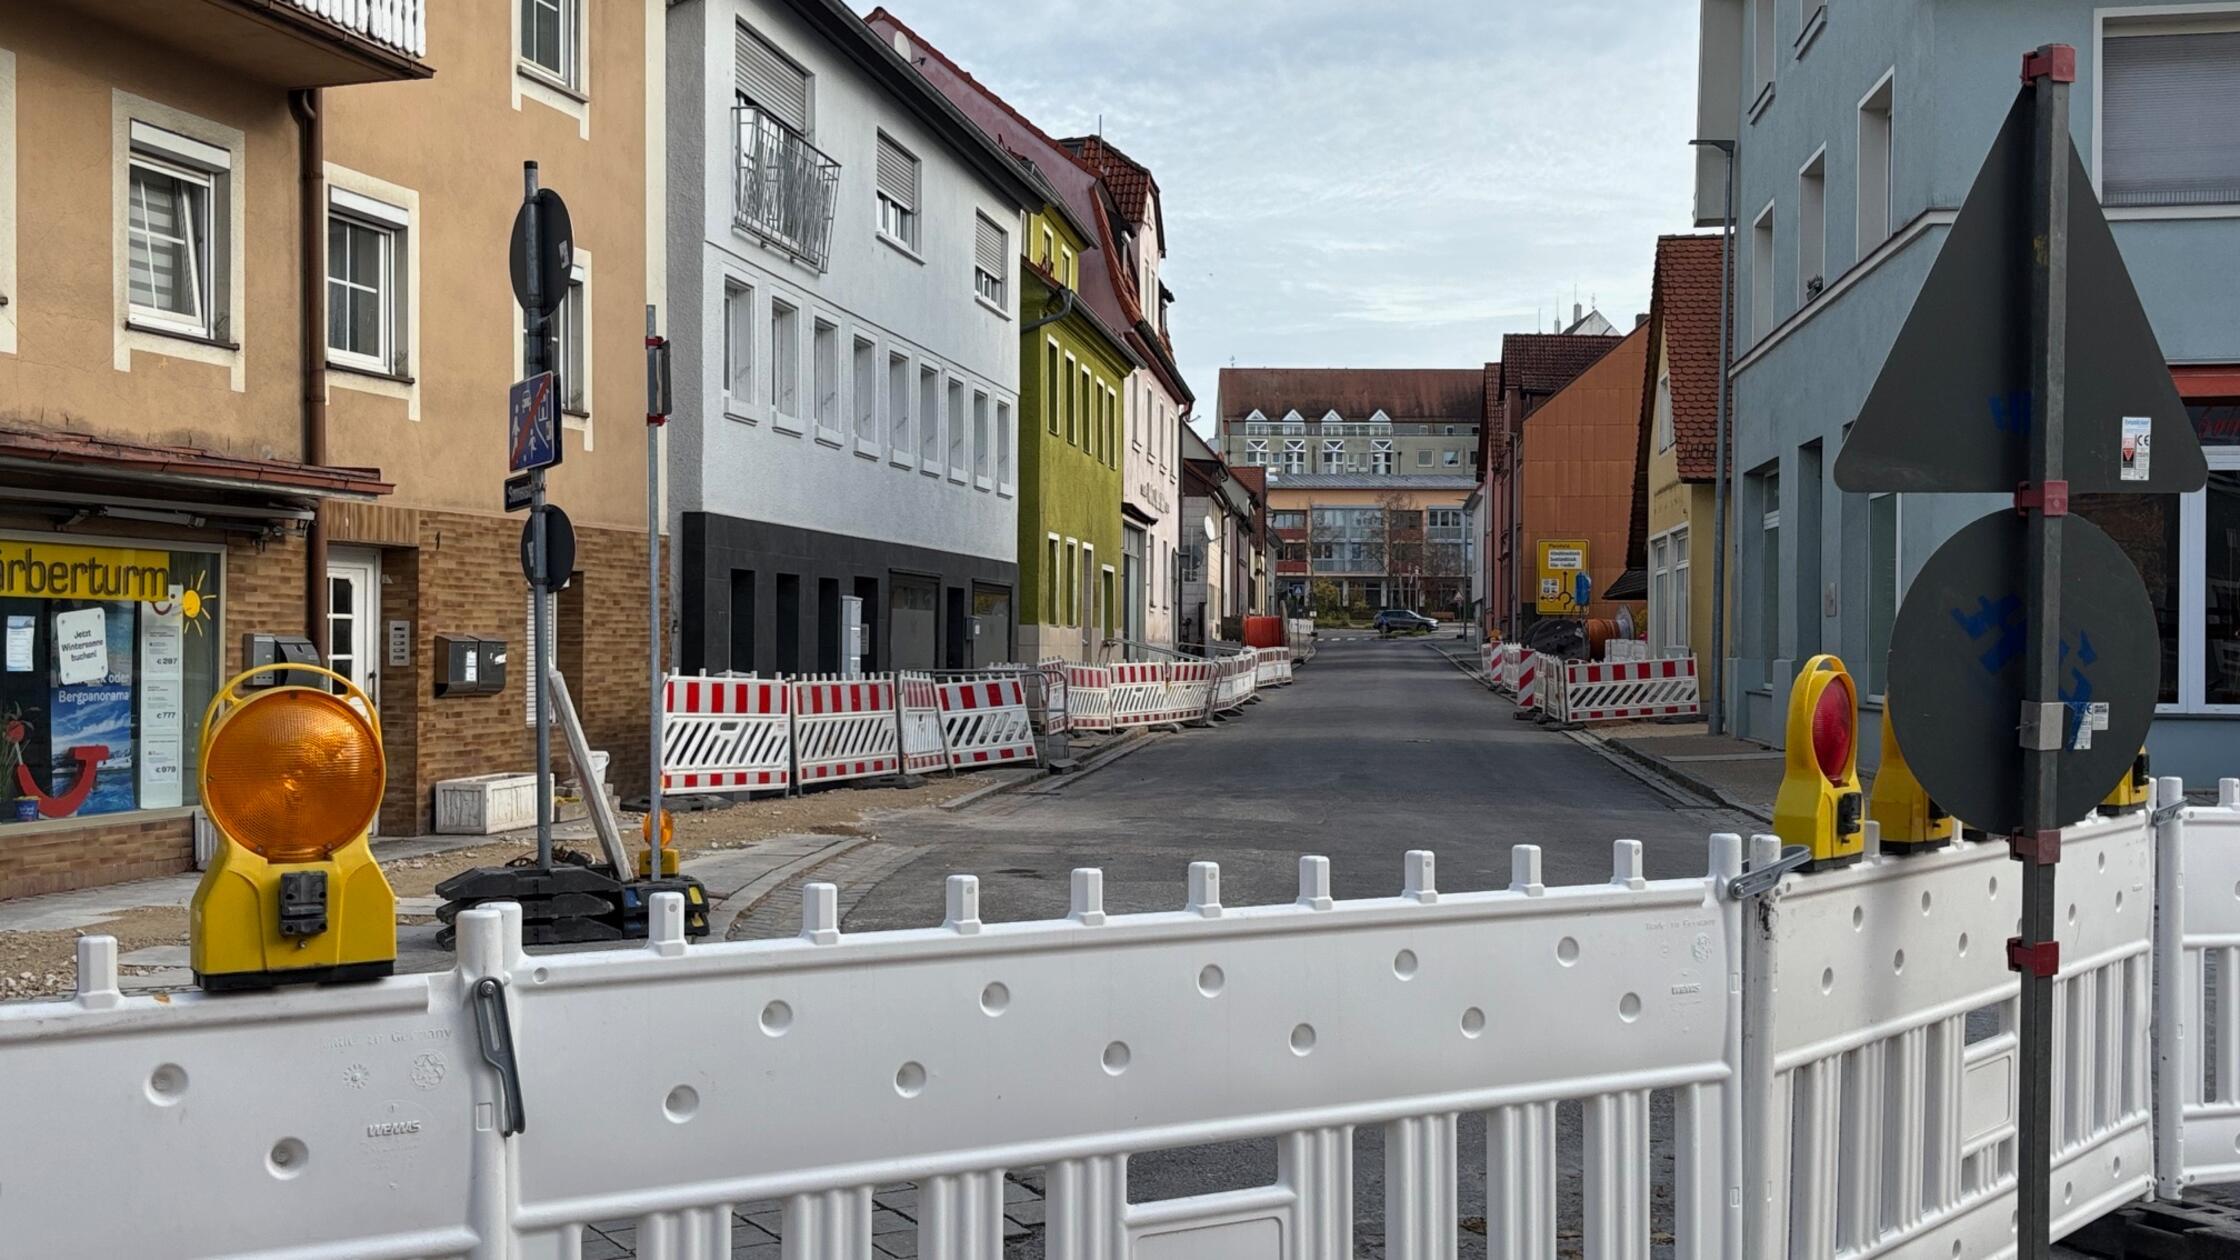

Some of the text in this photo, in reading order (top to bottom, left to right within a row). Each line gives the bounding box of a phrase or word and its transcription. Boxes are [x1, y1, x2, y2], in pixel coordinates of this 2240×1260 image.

[0, 547, 169, 598] rberturm
[74, 629, 91, 639] Jetzt
[61, 640, 103, 652] Wintersonne
[58, 690, 129, 706] Bergpanorama
